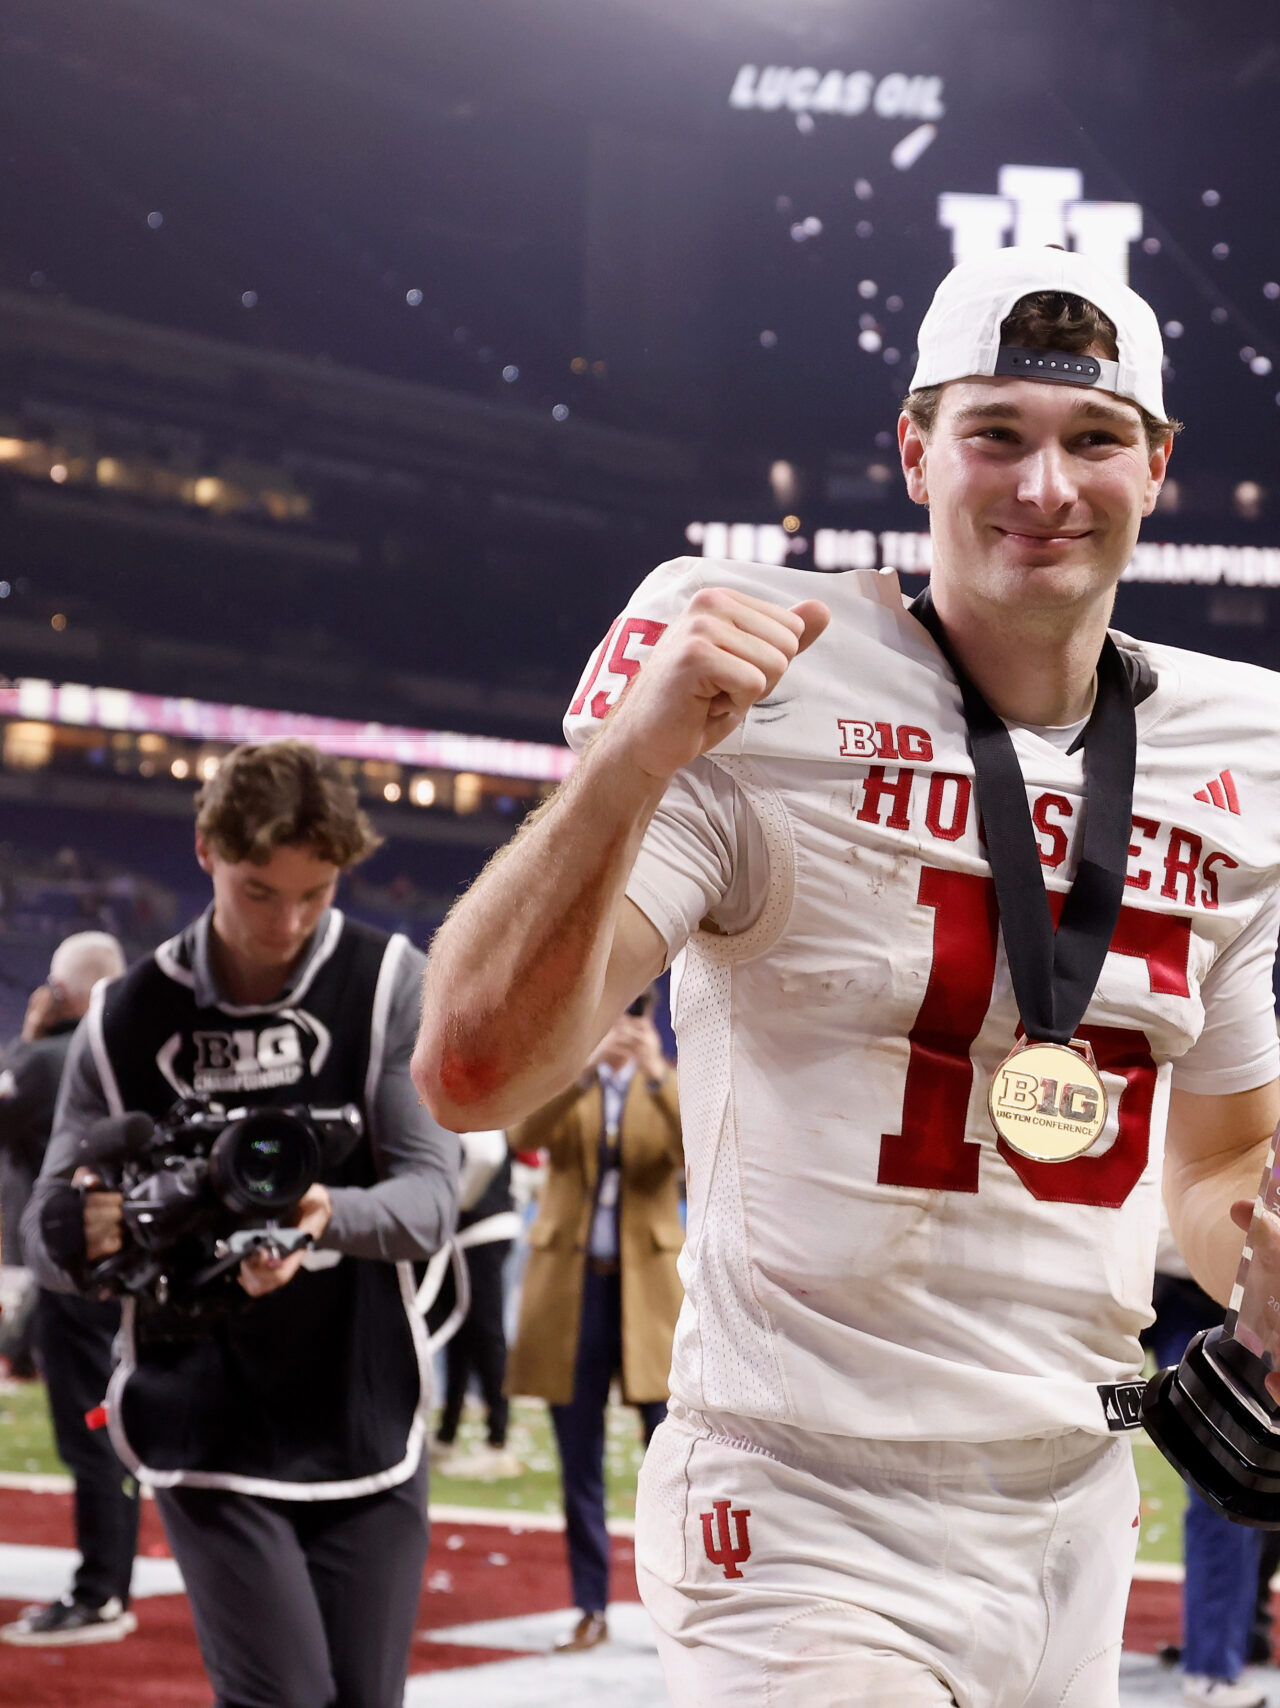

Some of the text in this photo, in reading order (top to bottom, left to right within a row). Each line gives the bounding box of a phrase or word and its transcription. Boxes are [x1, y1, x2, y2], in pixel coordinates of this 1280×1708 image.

[729, 64, 945, 120] LUCAS OIL
[856, 765, 1239, 910] HOSERS
[1032, 1116, 1095, 1137] CONFERENCE
